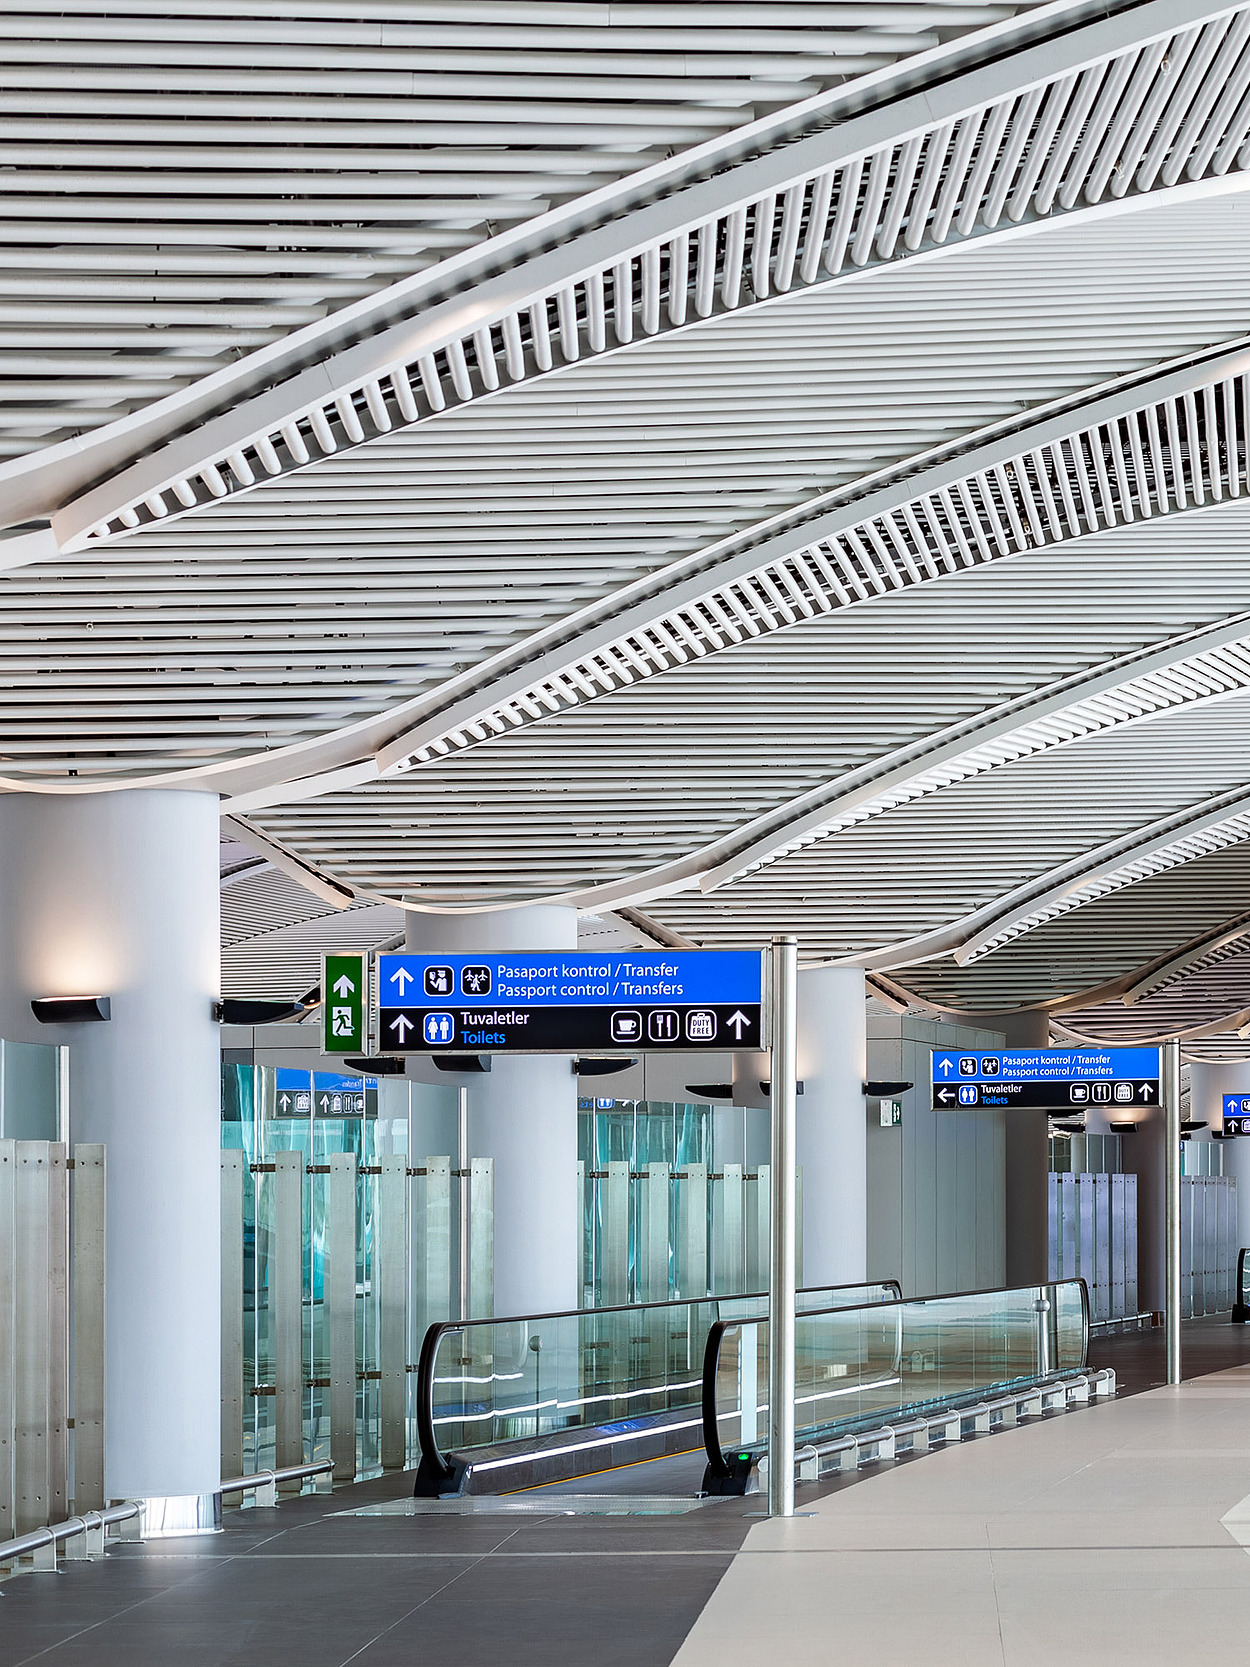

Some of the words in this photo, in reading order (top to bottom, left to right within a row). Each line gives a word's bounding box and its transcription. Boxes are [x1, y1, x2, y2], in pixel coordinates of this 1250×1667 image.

[498, 965, 558, 980] Pasaport
[562, 963, 611, 977] kontrol
[623, 963, 679, 976] Transfer
[498, 984, 556, 999] Passport
[561, 982, 609, 996] control
[621, 981, 683, 995] Transfers
[460, 1011, 529, 1025] Tuvaletler
[460, 1031, 506, 1044] Toilets
[1003, 1056, 1038, 1066] Pasaport
[1041, 1055, 1070, 1064] kontrol
[1077, 1055, 1110, 1063] Transfer
[1003, 1068, 1038, 1077] Passport
[1040, 1067, 1069, 1075] control
[1076, 1066, 1113, 1075] Transfers
[981, 1084, 1022, 1093] Tuvaletler
[981, 1095, 1008, 1104] Toilets
